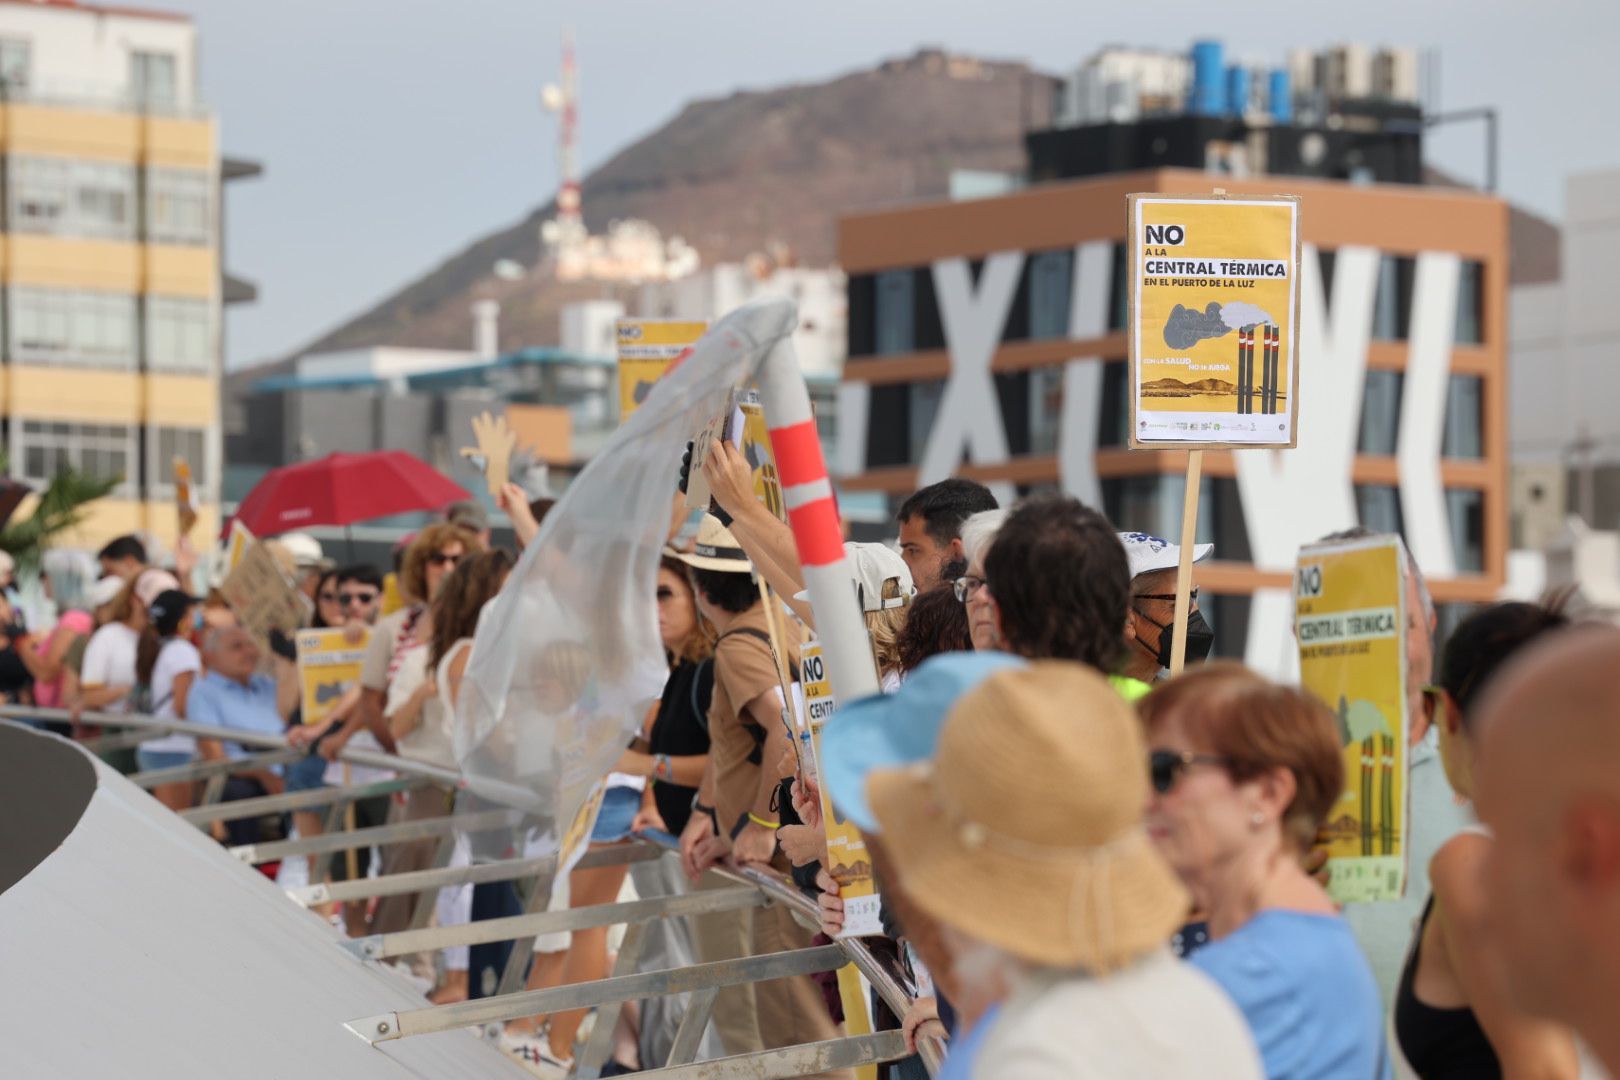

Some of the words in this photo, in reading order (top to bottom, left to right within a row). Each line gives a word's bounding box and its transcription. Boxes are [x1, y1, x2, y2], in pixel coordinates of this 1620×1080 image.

[1145, 225, 1184, 245] NO
[1145, 248, 1153, 256] A
[1155, 248, 1167, 256] LA
[1145, 260, 1216, 275] CENTRAL
[1220, 259, 1286, 277] TÉRMICA
[1144, 277, 1157, 286] EN
[1160, 278, 1169, 286] EL
[1171, 278, 1207, 287] PUERTO
[1209, 279, 1221, 287] DE
[1223, 279, 1236, 288] LA
[1238, 279, 1255, 288] LUZ
[1164, 357, 1191, 365] SALUD
[1298, 566, 1321, 595] NO
[1299, 618, 1344, 641] CENTRAL
[803, 656, 824, 682] NO
[806, 688, 811, 697] A
[811, 686, 819, 697] LA
